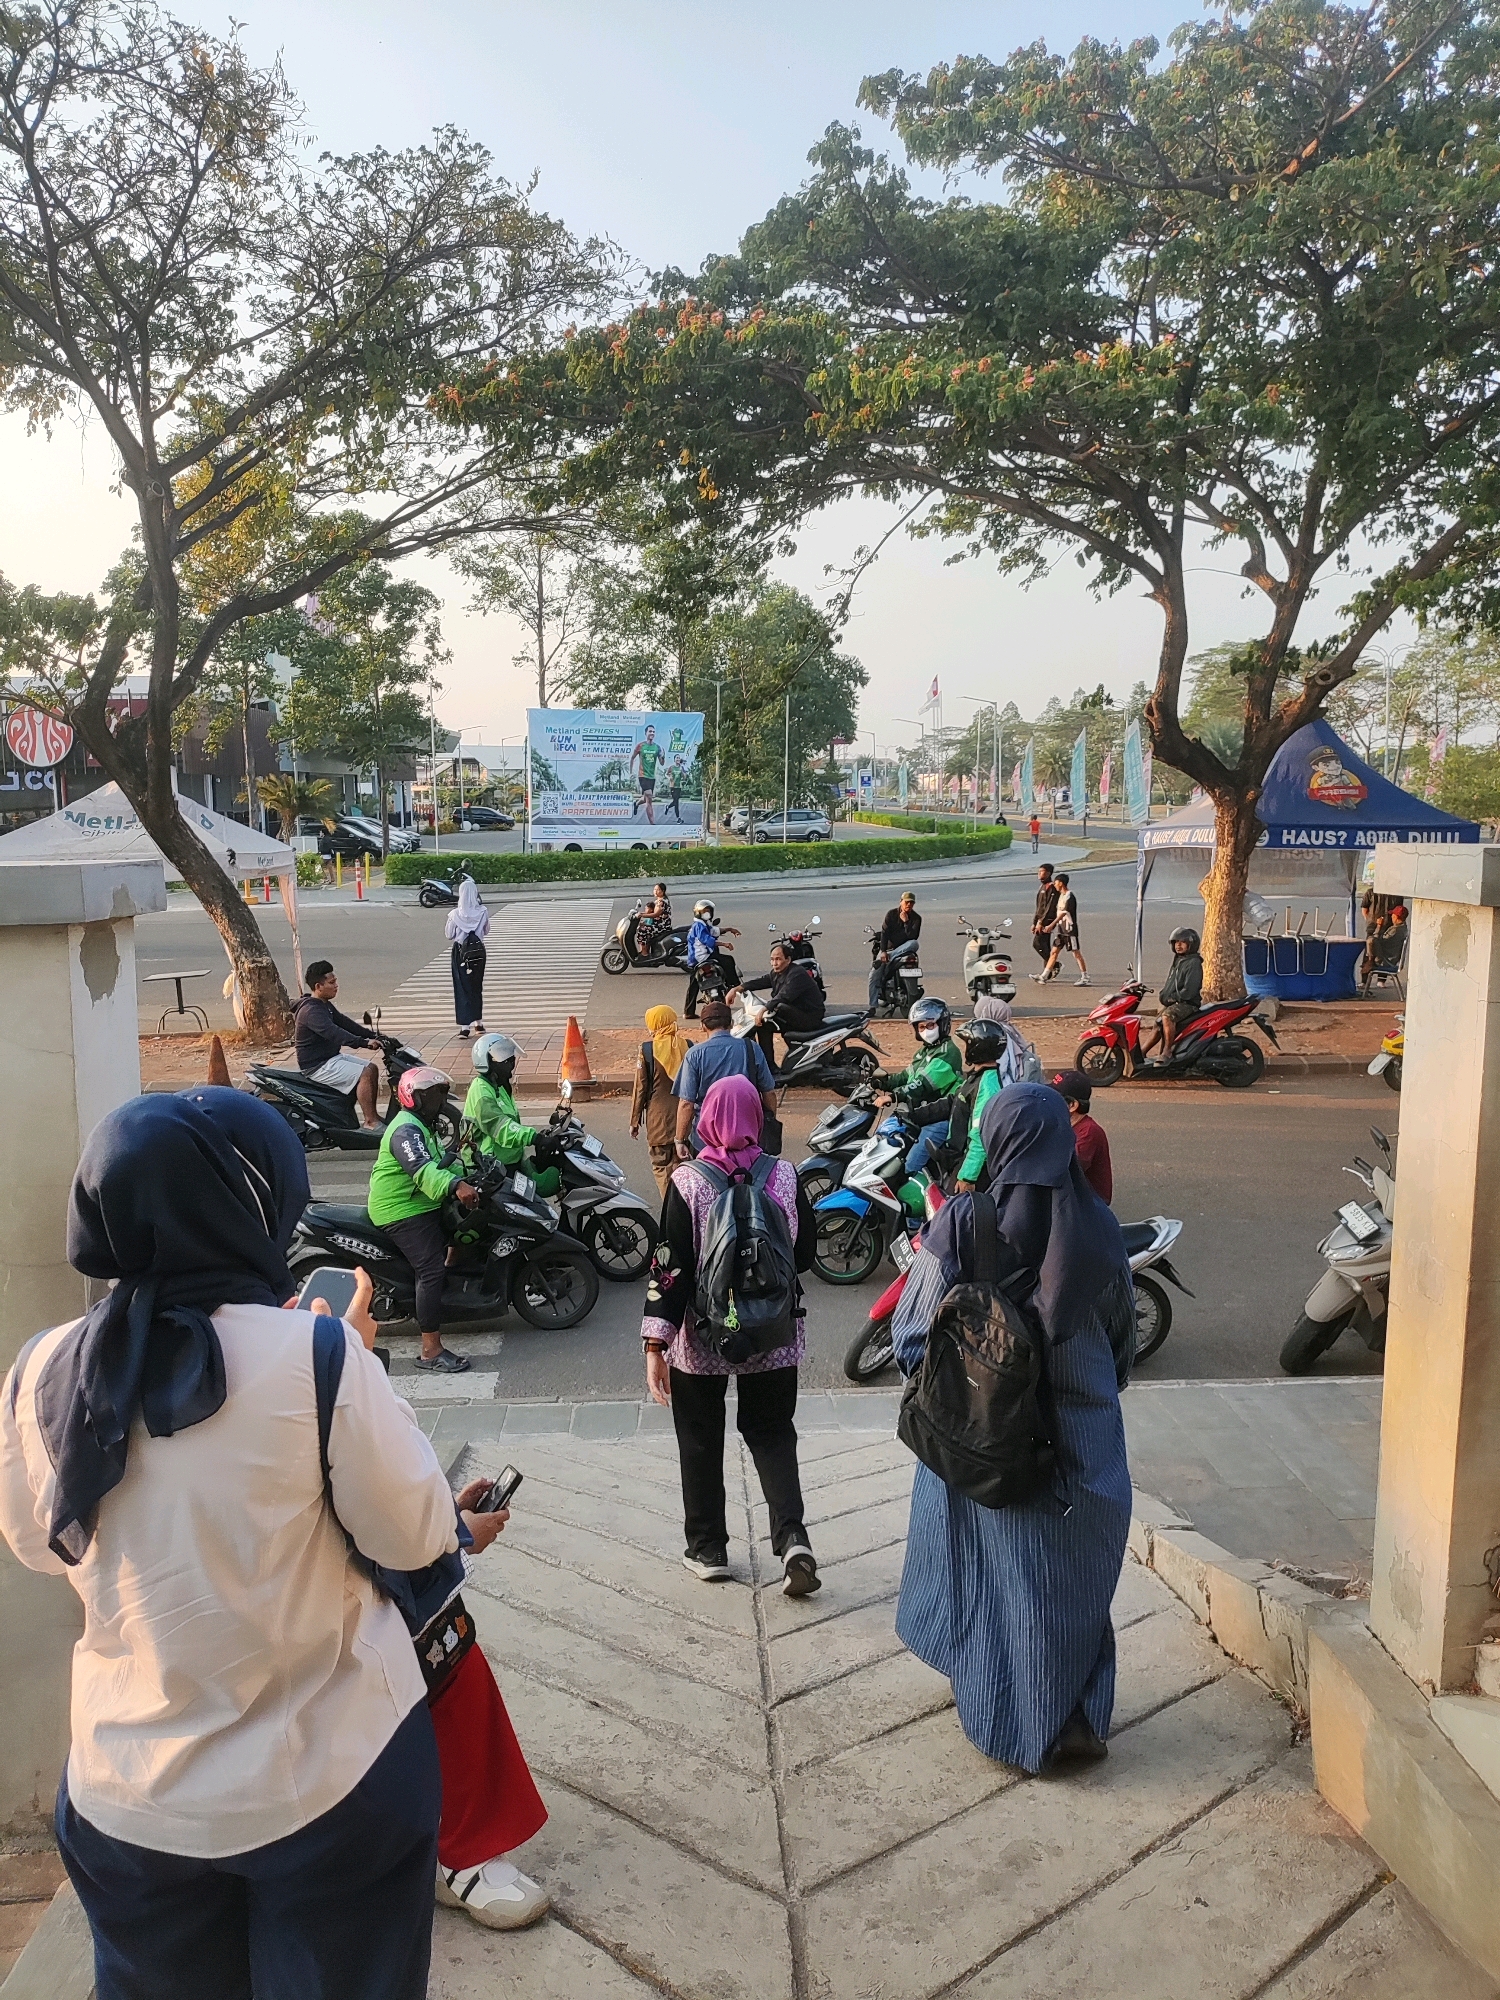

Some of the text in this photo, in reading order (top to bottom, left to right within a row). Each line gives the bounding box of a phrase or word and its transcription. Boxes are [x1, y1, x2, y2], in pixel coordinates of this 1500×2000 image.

[545, 726, 581, 735] Metland
[550, 735, 572, 744] RUN
[592, 746, 632, 754] METLAND
[561, 808, 629, 816] APARTEMENNYA
[1151, 828, 1216, 846] HAUS? AQUA DULU
[1281, 829, 1460, 846] HAUS? AQUA DULU
[401, 1140, 416, 1162] gopay
[337, 1236, 382, 1256] STREET
